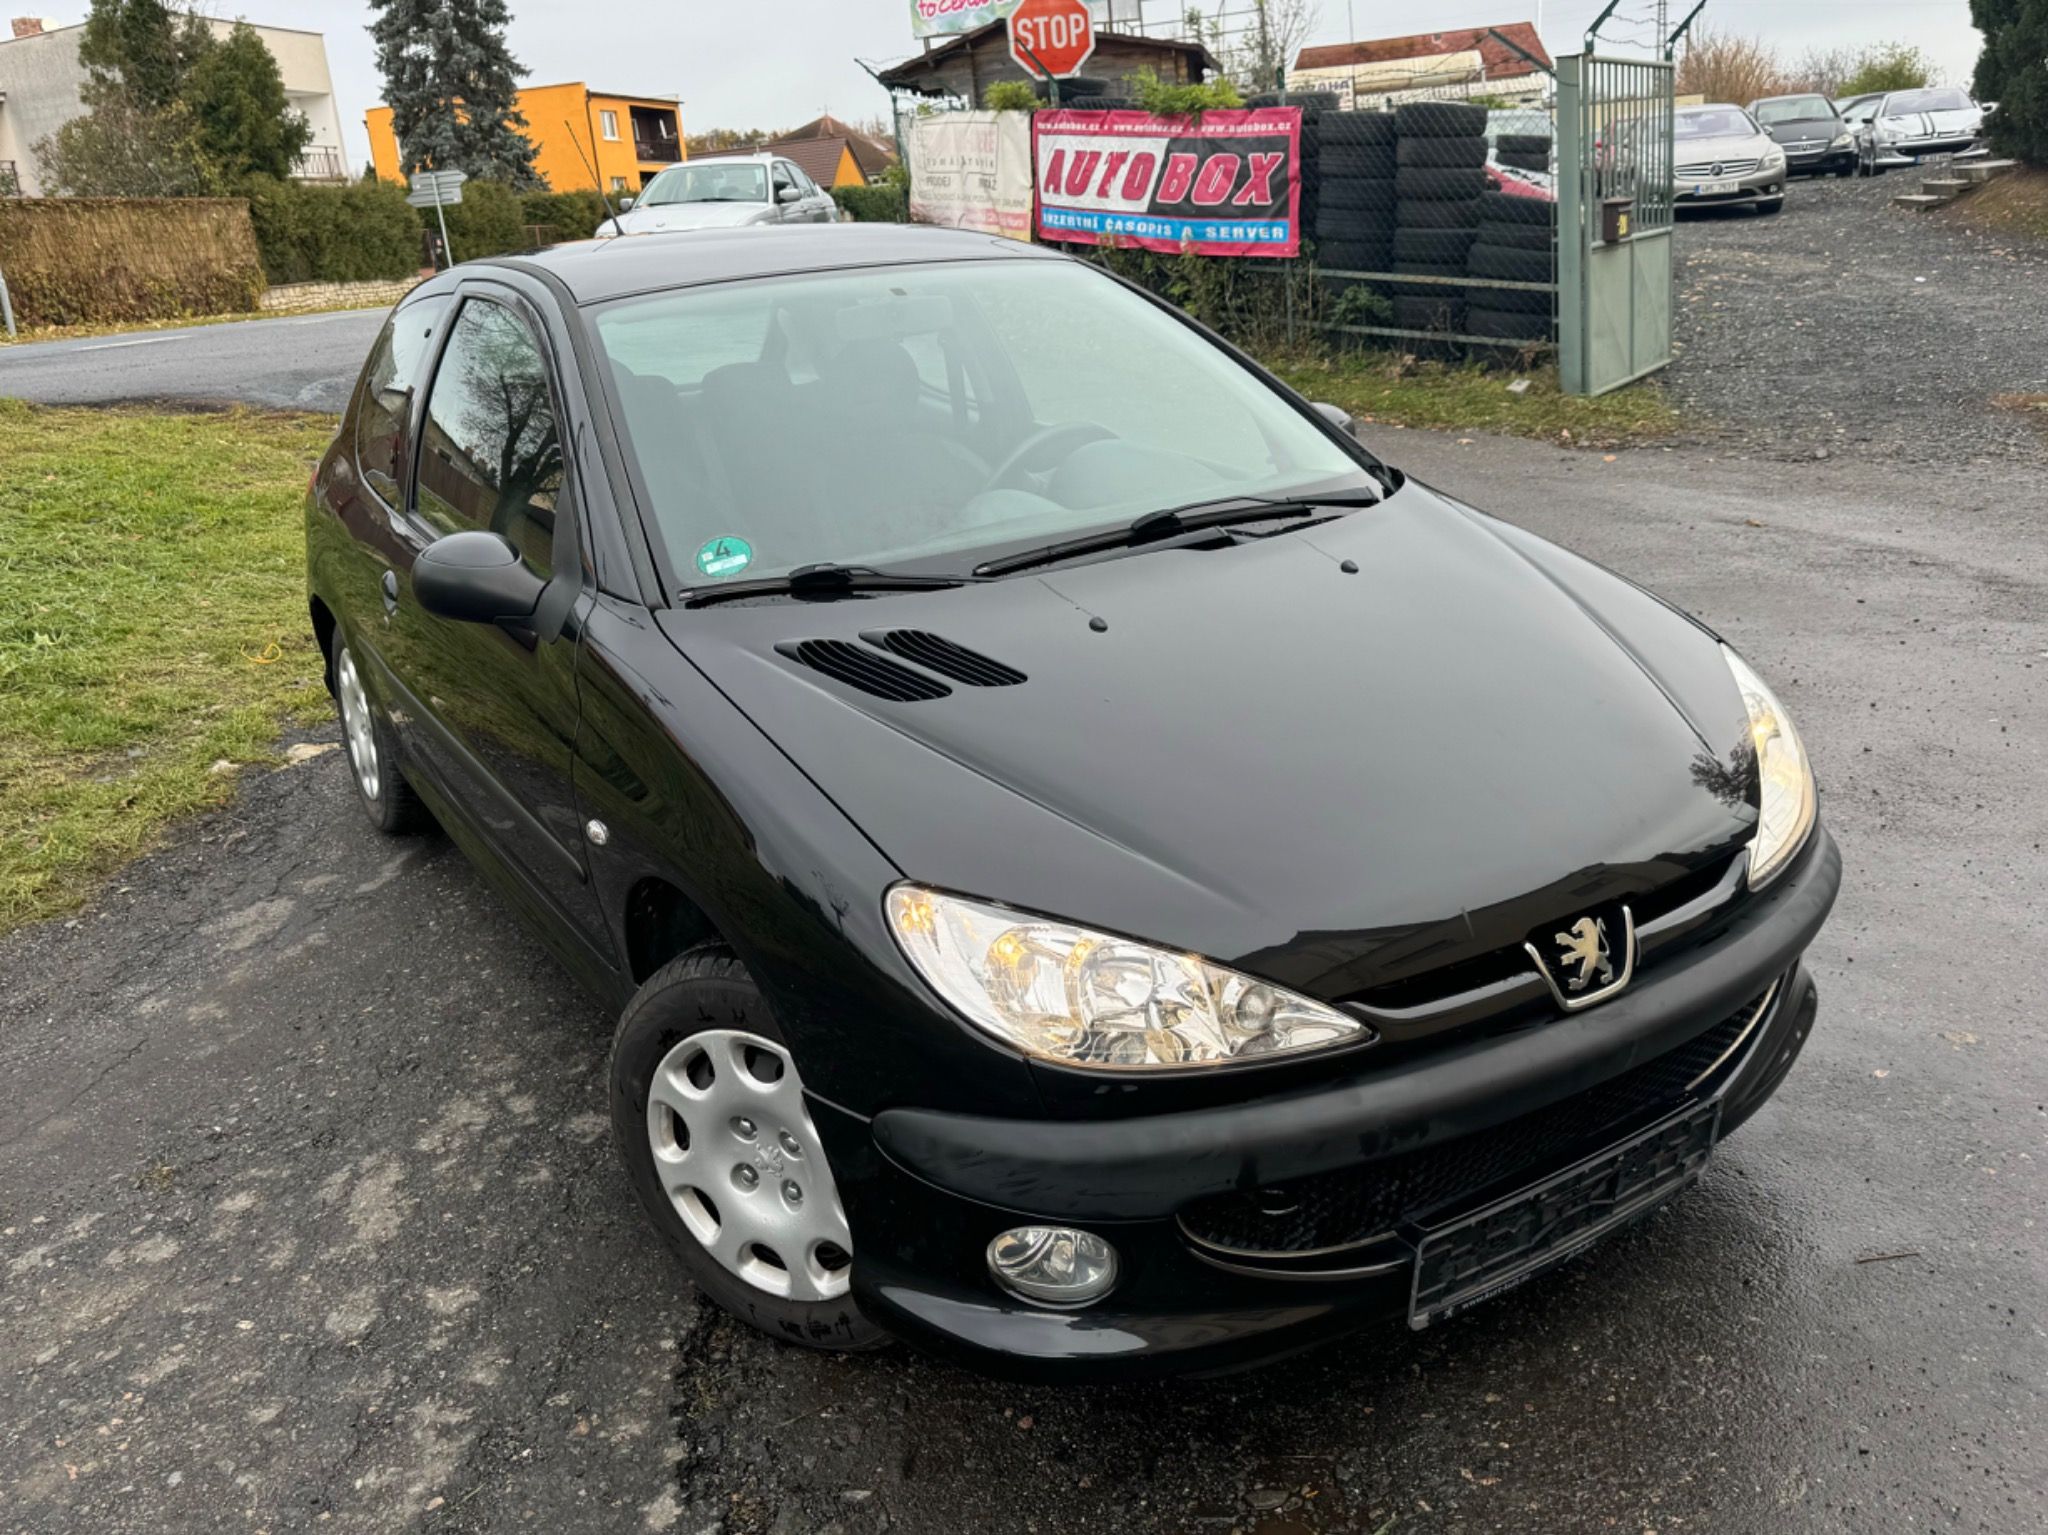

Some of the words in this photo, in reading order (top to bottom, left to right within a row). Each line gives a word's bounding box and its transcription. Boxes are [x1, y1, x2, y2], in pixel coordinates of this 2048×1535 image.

[1016, 13, 1085, 52] STOP
[1201, 121, 1292, 134] www.autobox.cz
[1104, 217, 1172, 237] ČASOPIS
[1205, 225, 1285, 240] SERVER
[715, 540, 731, 558] 4
